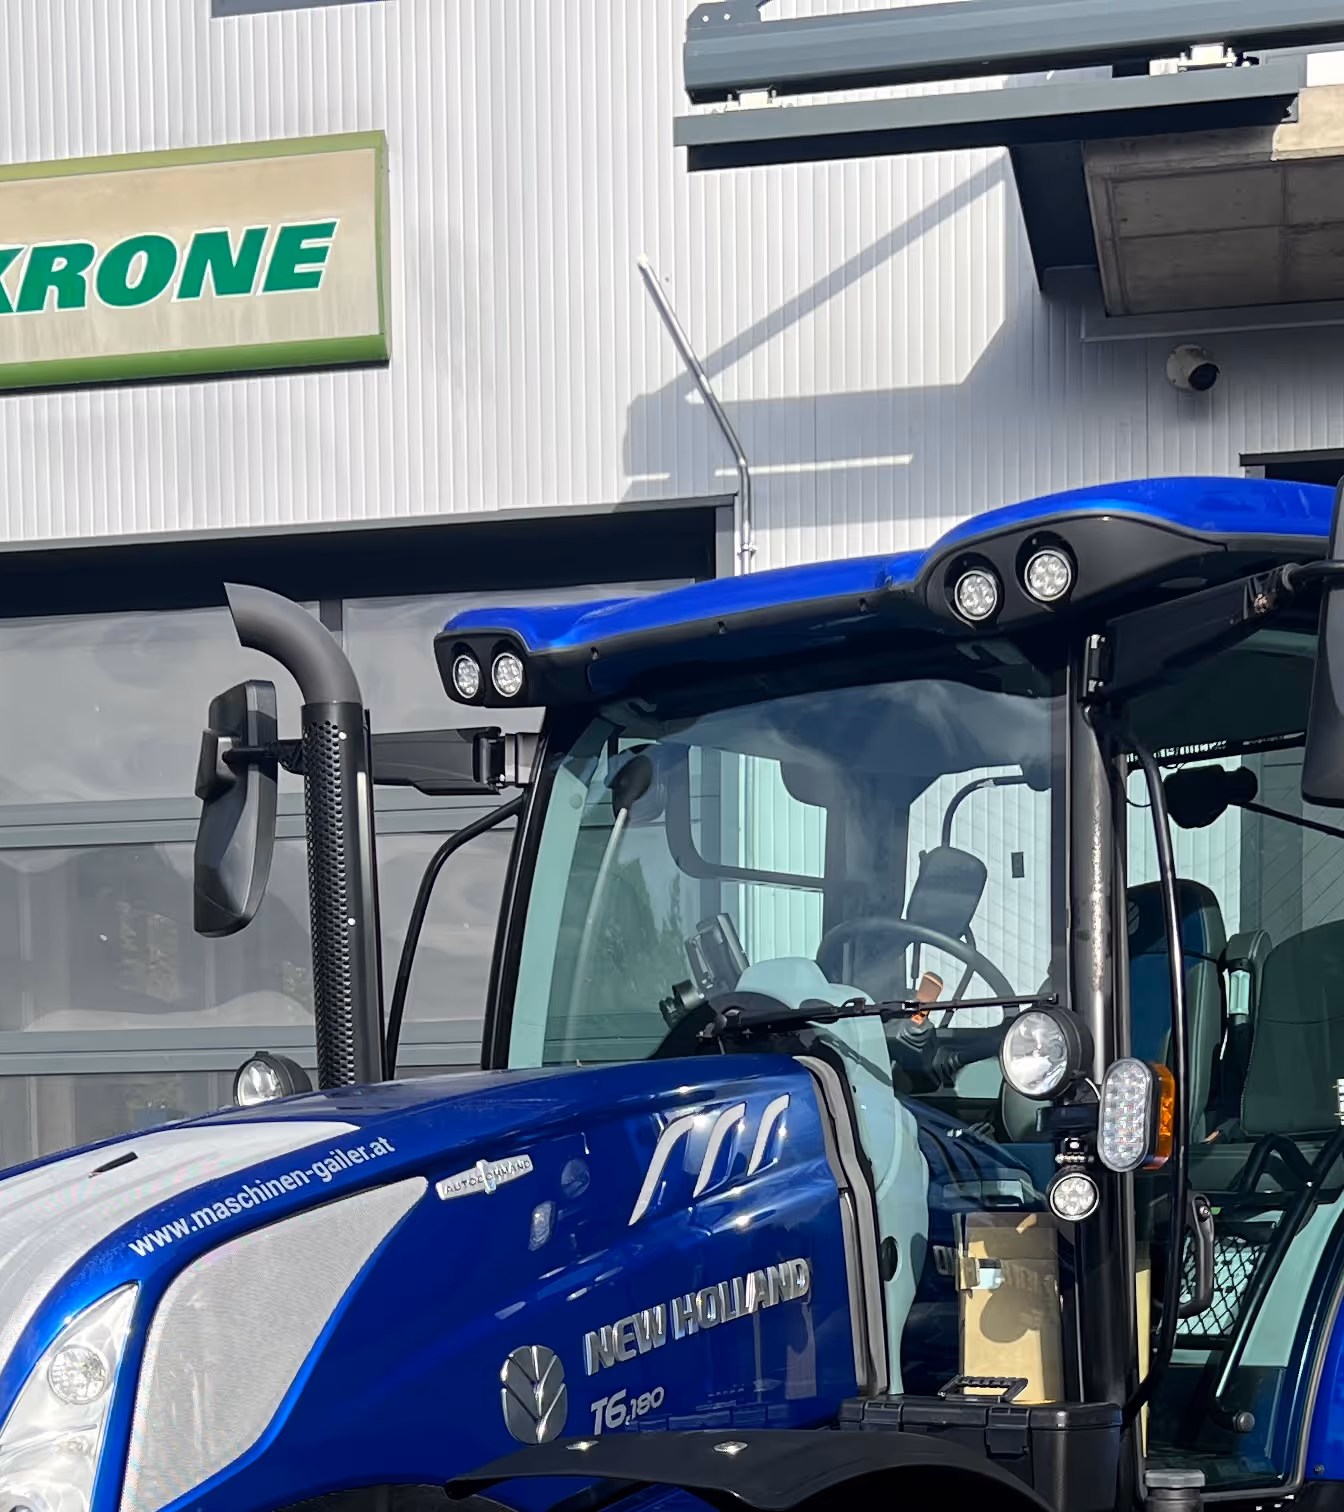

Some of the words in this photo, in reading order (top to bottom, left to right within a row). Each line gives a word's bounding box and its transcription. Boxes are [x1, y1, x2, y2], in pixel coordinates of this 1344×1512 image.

[128, 1136, 395, 1257] www.maschinen-gailer.at
[445, 1160, 532, 1196] AUTOCOMMAND
[583, 1304, 667, 1376] NEW
[670, 1257, 810, 1341] HOLLAND
[590, 1386, 665, 1436] T6.180
